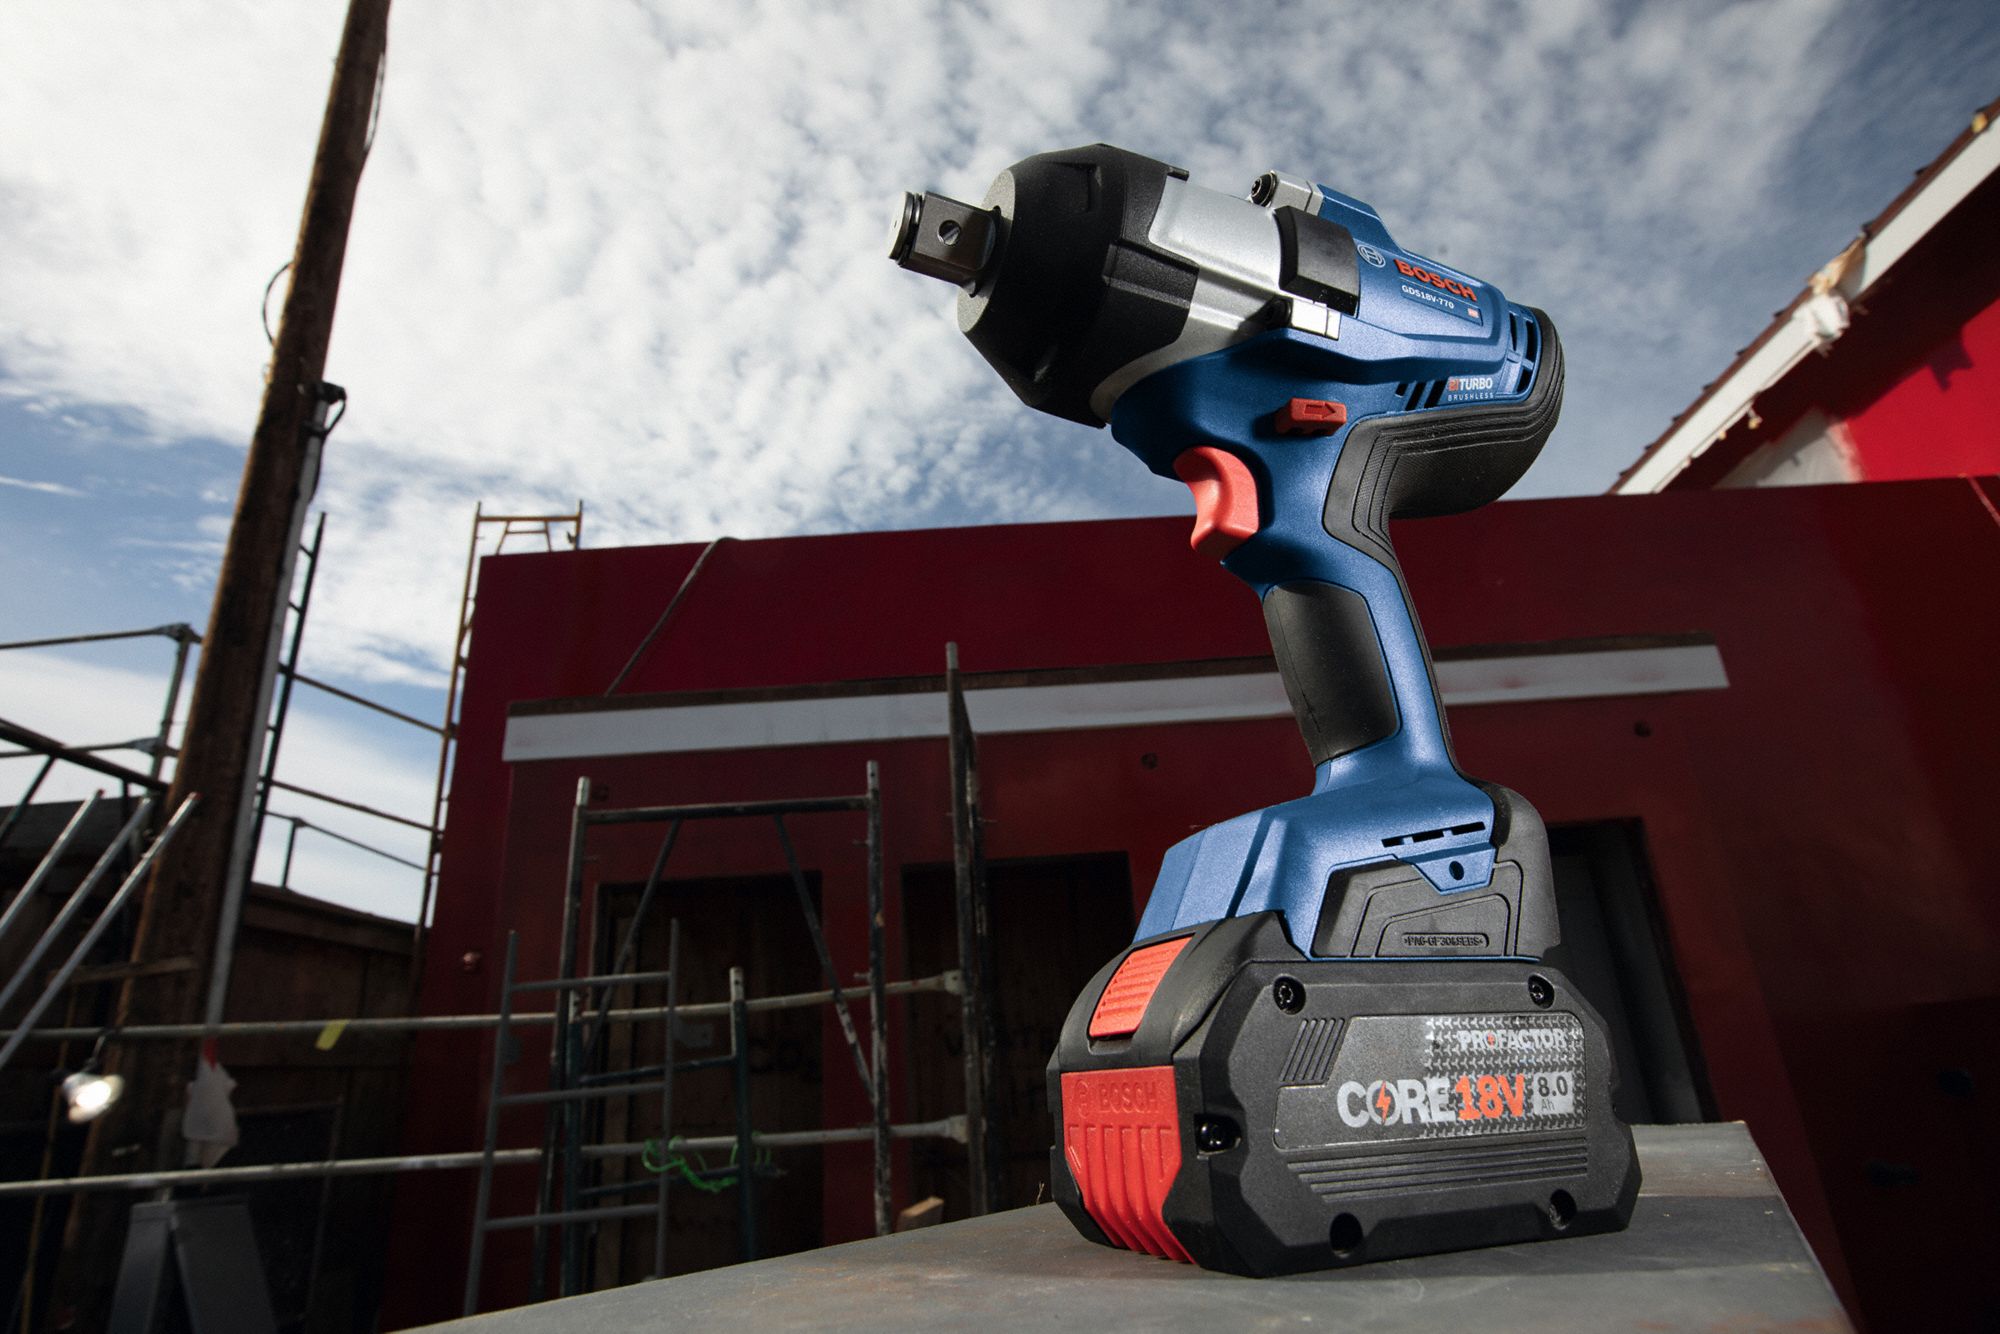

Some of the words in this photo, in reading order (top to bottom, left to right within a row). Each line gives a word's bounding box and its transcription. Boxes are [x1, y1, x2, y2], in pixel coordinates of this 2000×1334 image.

[1394, 258, 1477, 302] BOSCH
[1401, 284, 1455, 310] GDS18V-770
[1447, 392, 1494, 402] BRUSHLESS
[1457, 1028, 1568, 1051] PROFACTOR
[1097, 1080, 1160, 1115] BOSCH
[1537, 1075, 1569, 1098] 8.0
[1540, 1098, 1555, 1110] Ah
